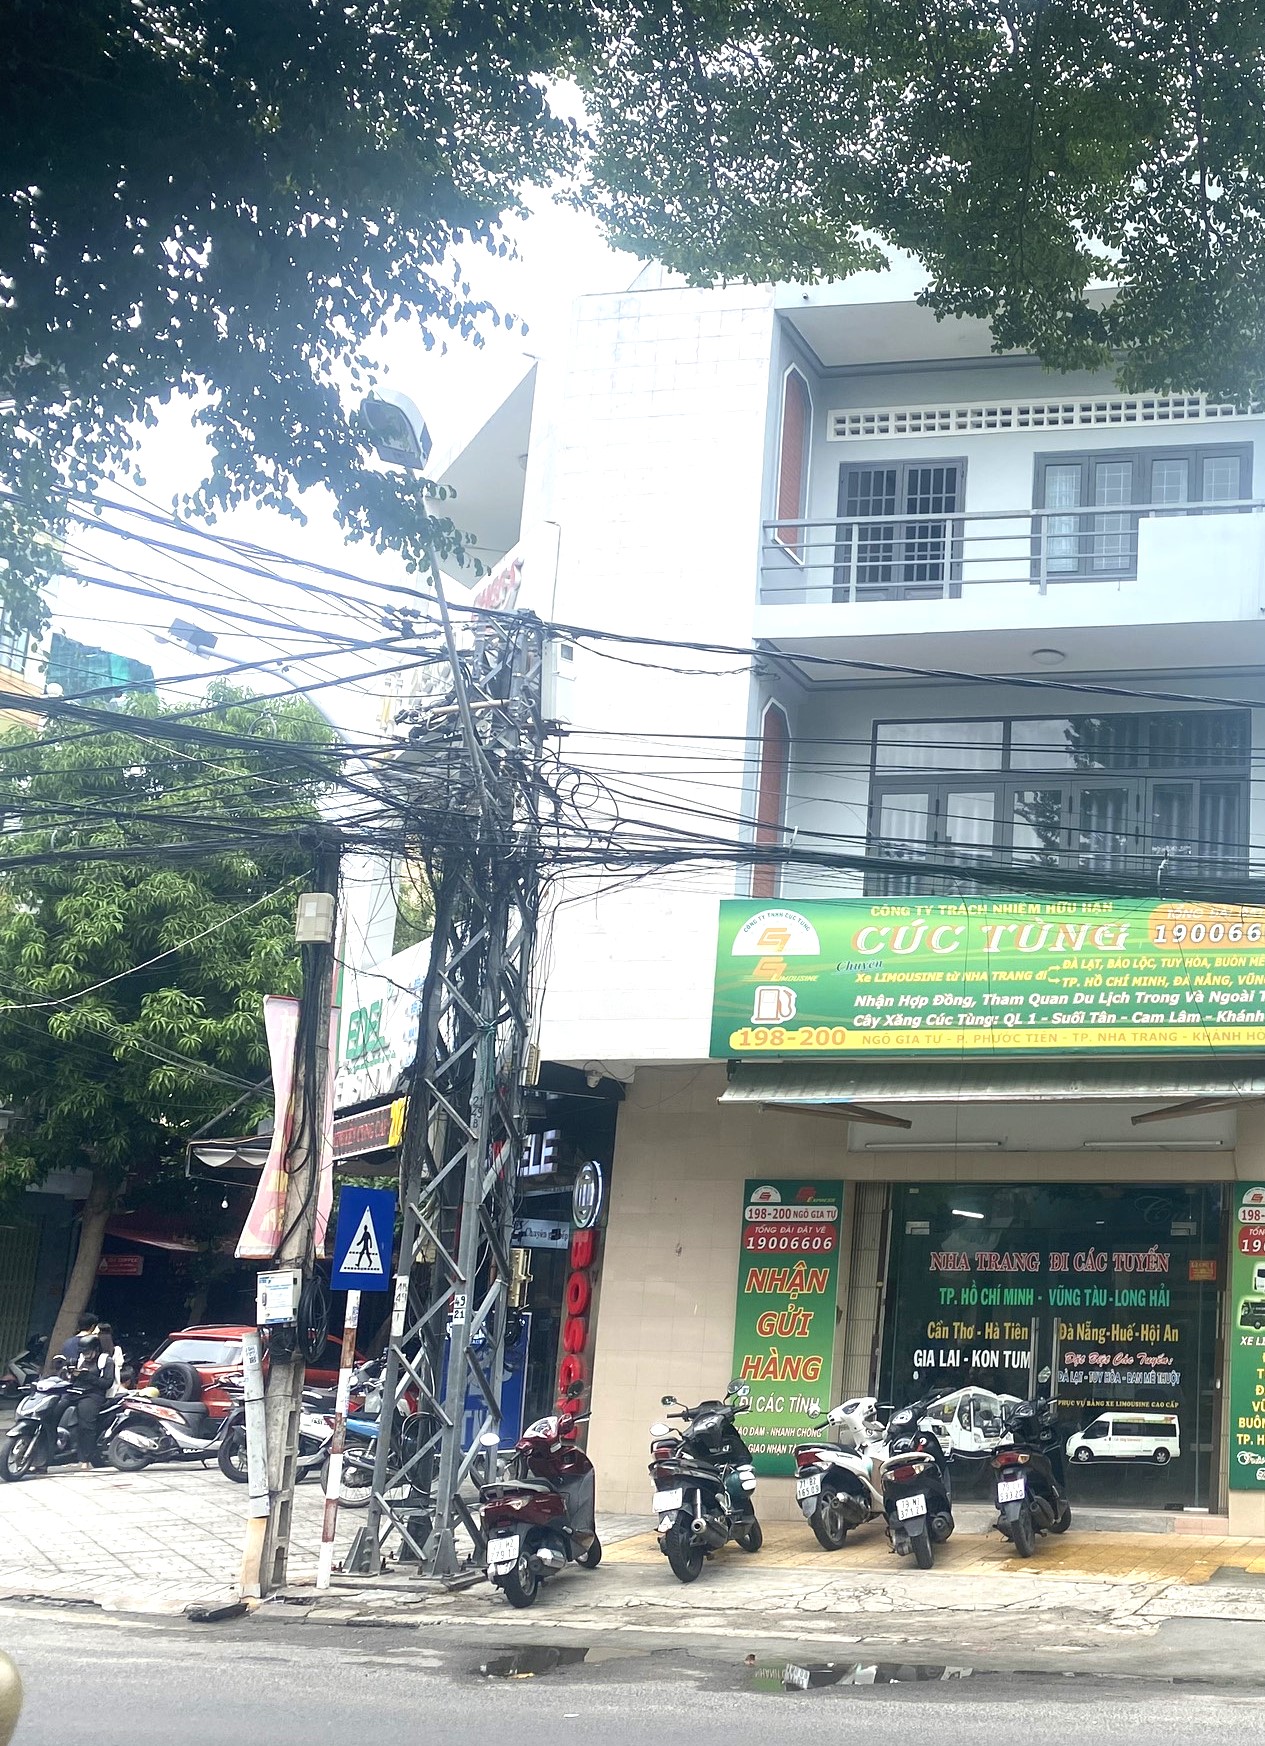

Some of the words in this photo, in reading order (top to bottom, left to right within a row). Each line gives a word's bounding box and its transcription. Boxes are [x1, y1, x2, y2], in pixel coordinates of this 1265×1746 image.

[871, 904, 910, 916] CÔNG
[915, 905, 933, 916] TY
[938, 903, 988, 915] TRÁCH
[992, 903, 1040, 915] NHIỆM
[1081, 902, 1113, 914] HẠN
[852, 918, 966, 955] CÚC
[979, 916, 1131, 953] TÙNG
[1062, 957, 1078, 969] ĐÀ
[1081, 958, 1104, 971] LẠT,
[1133, 957, 1157, 970] LỘC,
[1161, 958, 1182, 968] TUY
[1185, 956, 1211, 969] HÒA,
[1214, 955, 1246, 967] BUÔN
[1248, 954, 1265, 967] MÊ
[855, 972, 872, 982] Xe
[874, 972, 944, 982] LIMOUSINE
[946, 971, 960, 981] từ
[962, 971, 988, 981] NHA
[991, 971, 1033, 981] TRANG
[1035, 970, 1048, 981] đi
[1062, 977, 1080, 988] TP.
[1083, 973, 1103, 987] HỒ
[1106, 974, 1130, 987] CHÍ
[1131, 976, 1169, 987] MINH,
[854, 994, 894, 1009] Nhận
[898, 995, 929, 1009] Hợp
[932, 993, 977, 1009] Đồng,
[982, 993, 1024, 1006] Tham
[1028, 993, 1069, 1007] Quan
[1073, 992, 1095, 1005] Du
[1099, 992, 1131, 1006] Lịch
[1135, 992, 1180, 1005] Trong
[1185, 990, 1205, 1003] Và
[1208, 989, 1255, 1005] Ngoài
[853, 1013, 881, 1029] Cây
[883, 1013, 922, 1028] Xăng
[926, 1013, 954, 1026] Cúc
[957, 1012, 999, 1027] Tùng:
[1003, 1013, 1022, 1027] QL
[1027, 1013, 1037, 1025] 1
[1051, 1010, 1086, 1025] Suối
[1089, 1010, 1117, 1023] Tân
[1131, 1012, 1165, 1024] Cam
[1168, 1010, 1200, 1023] Lâm
[1216, 1010, 1265, 1022] Khánh
[739, 1029, 846, 1046] 198-200
[862, 1032, 891, 1045] NGÔ
[896, 1034, 922, 1044] GIA
[956, 1034, 968, 1044] P.
[974, 1032, 1021, 1044] PHƯỚC
[1072, 1033, 1093, 1043] TP.
[1098, 1032, 1126, 1041] NHA
[1131, 1032, 1178, 1041] TRANG
[1192, 1028, 1241, 1041] KHÁNH
[748, 1208, 791, 1220] 198-200
[793, 1208, 809, 1218] NGÔ
[811, 1210, 824, 1218] GIA
[746, 1236, 833, 1250] 19006606
[929, 1252, 971, 1271] NHA
[975, 1252, 1040, 1271] TRANG
[1049, 1252, 1070, 1272] ĐI
[1073, 1246, 1108, 1272] CÁC
[1112, 1244, 1170, 1272] TUYẾN
[744, 1260, 829, 1299] NHẬN
[939, 1287, 958, 1305] TP.
[961, 1279, 978, 1305] HỒ
[980, 1283, 1001, 1305] CHÍ
[1003, 1288, 1034, 1305] MINH
[1048, 1284, 1081, 1306] VŨNG
[1150, 1283, 1170, 1307] HẢI
[454, 1310, 465, 1319] 21
[756, 1304, 814, 1338] GỬI
[927, 1320, 949, 1339] Cần
[952, 1322, 975, 1339] Thơ
[984, 1321, 1000, 1339] Hà
[1003, 1322, 1028, 1340] Tiên
[1059, 1322, 1074, 1340] Đà
[1163, 1324, 1179, 1341] An
[1240, 1336, 1254, 1346] XE
[740, 1347, 823, 1382] HÀNG
[913, 1349, 935, 1367] GIA
[939, 1349, 960, 1367] LAI
[971, 1349, 999, 1368] KON
[1003, 1350, 1031, 1368] TUM
[756, 1392, 785, 1413] CÁC
[771, 1427, 795, 1436] NHANH
[1236, 1434, 1254, 1446] TP.
[748, 1444, 765, 1453] GIAO
